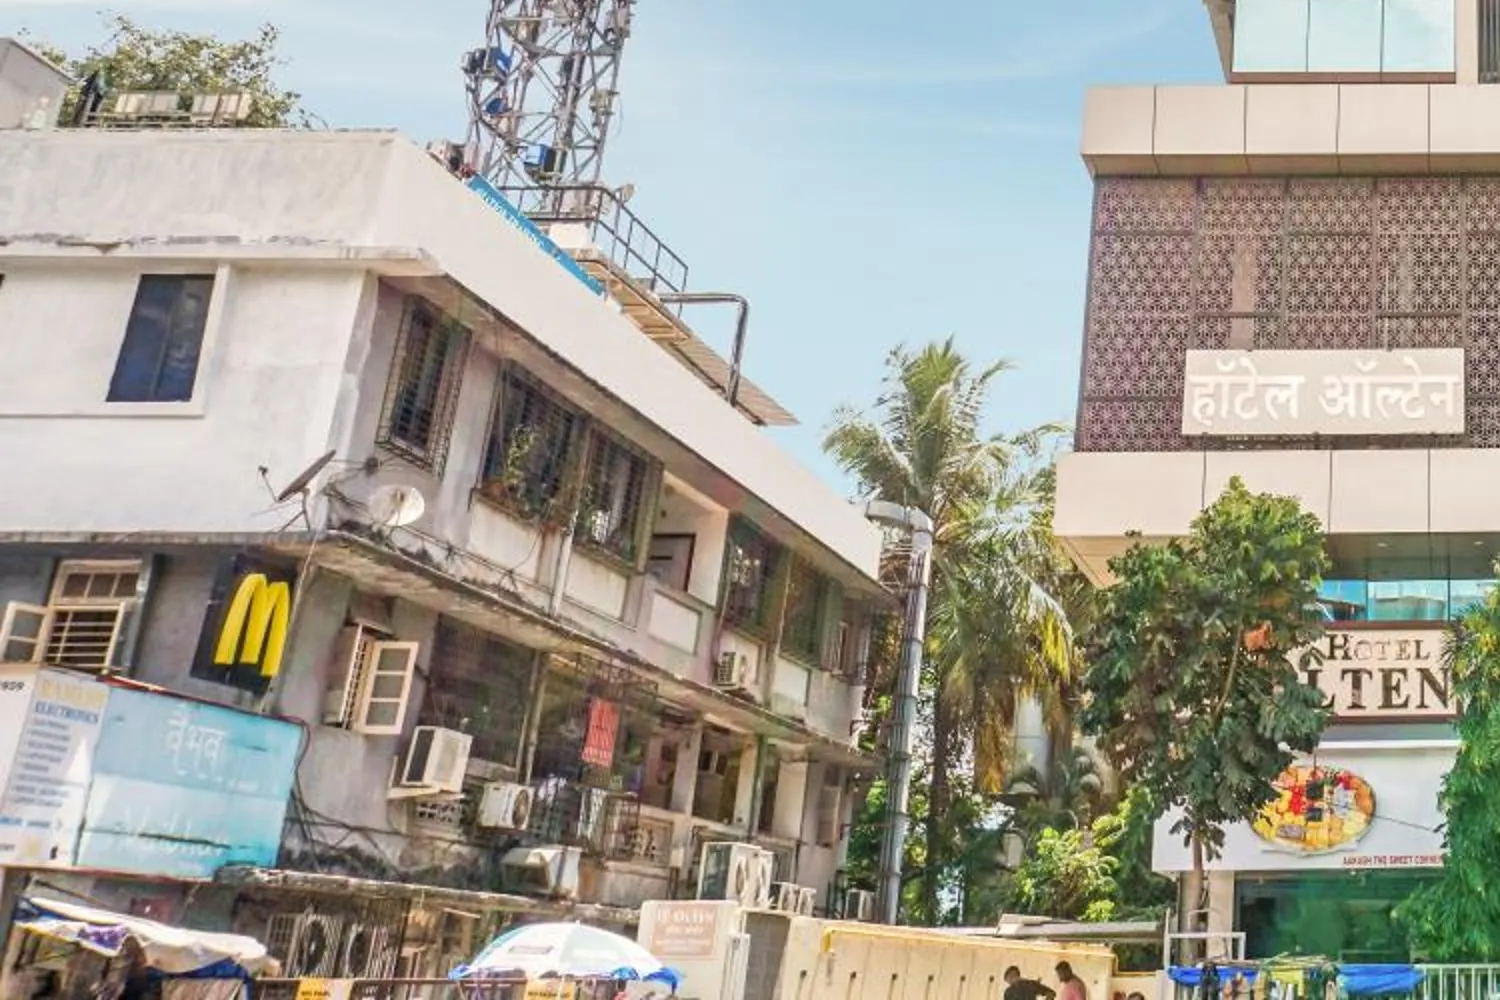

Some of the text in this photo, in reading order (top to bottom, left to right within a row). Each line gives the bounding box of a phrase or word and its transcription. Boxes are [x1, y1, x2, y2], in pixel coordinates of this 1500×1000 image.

[1188, 356, 1461, 425] हॉटेल ऑल्टेन
[1325, 633, 1431, 661] HOTEL
[1303, 667, 1450, 710] LTEN
